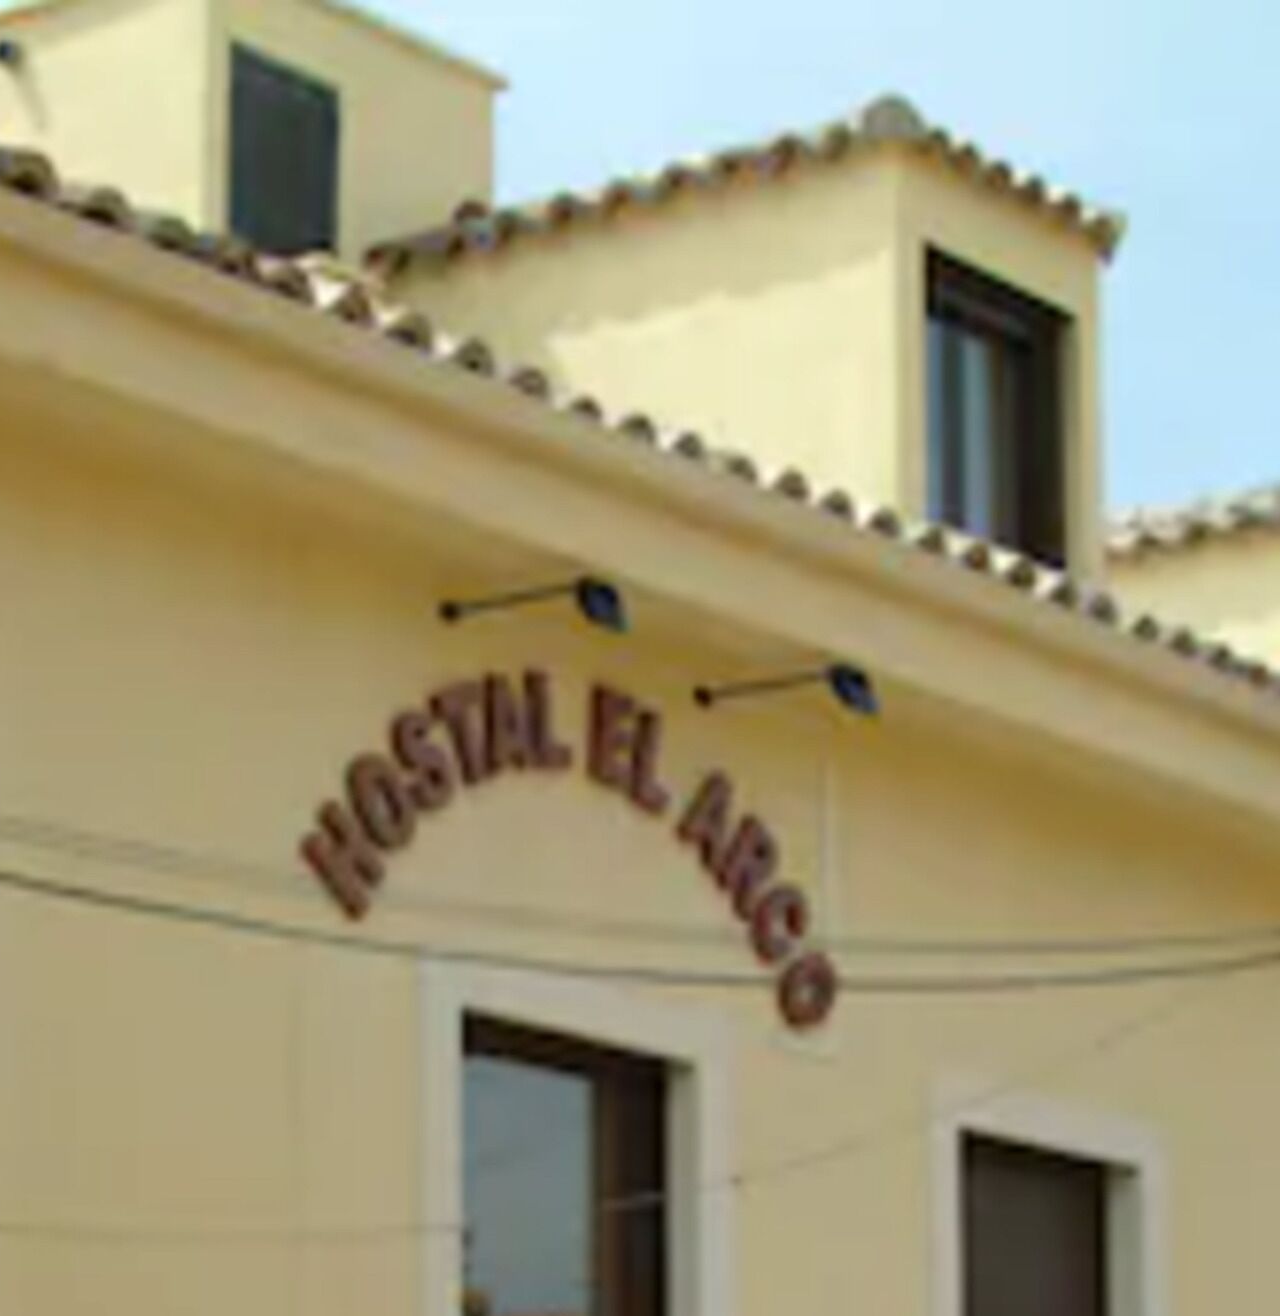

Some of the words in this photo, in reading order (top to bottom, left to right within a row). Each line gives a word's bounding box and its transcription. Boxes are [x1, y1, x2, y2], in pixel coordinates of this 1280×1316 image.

[299, 669, 573, 923] HOSTAL
[586, 683, 671, 819] EL
[675, 768, 837, 1033] ARCO
